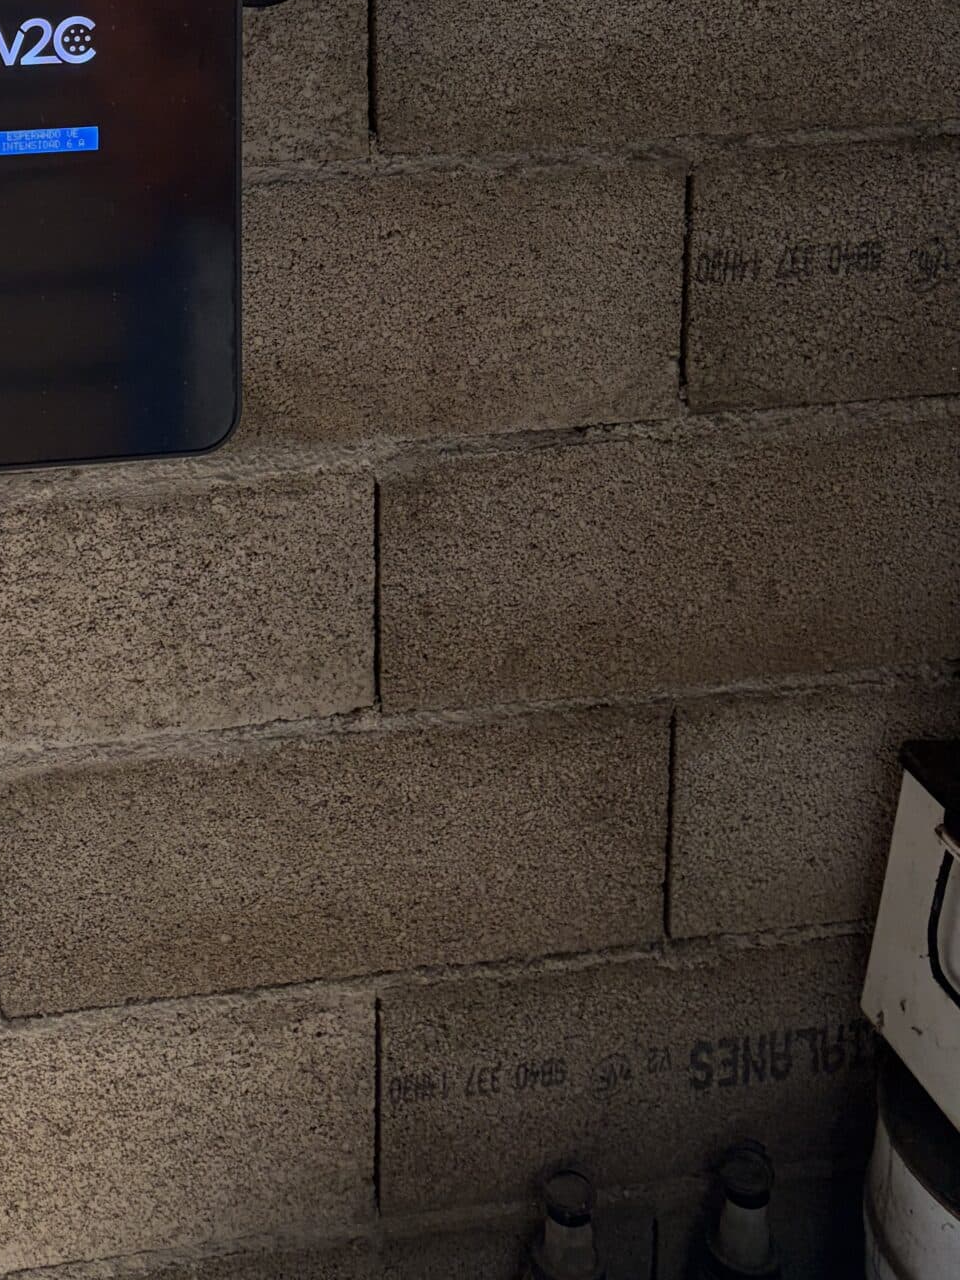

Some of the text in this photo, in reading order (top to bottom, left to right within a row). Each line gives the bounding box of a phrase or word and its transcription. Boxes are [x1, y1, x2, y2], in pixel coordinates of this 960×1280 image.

[6, 128, 80, 141] ESPERANDO VE
[1, 139, 85, 152] INTENSIDAD 6 A
